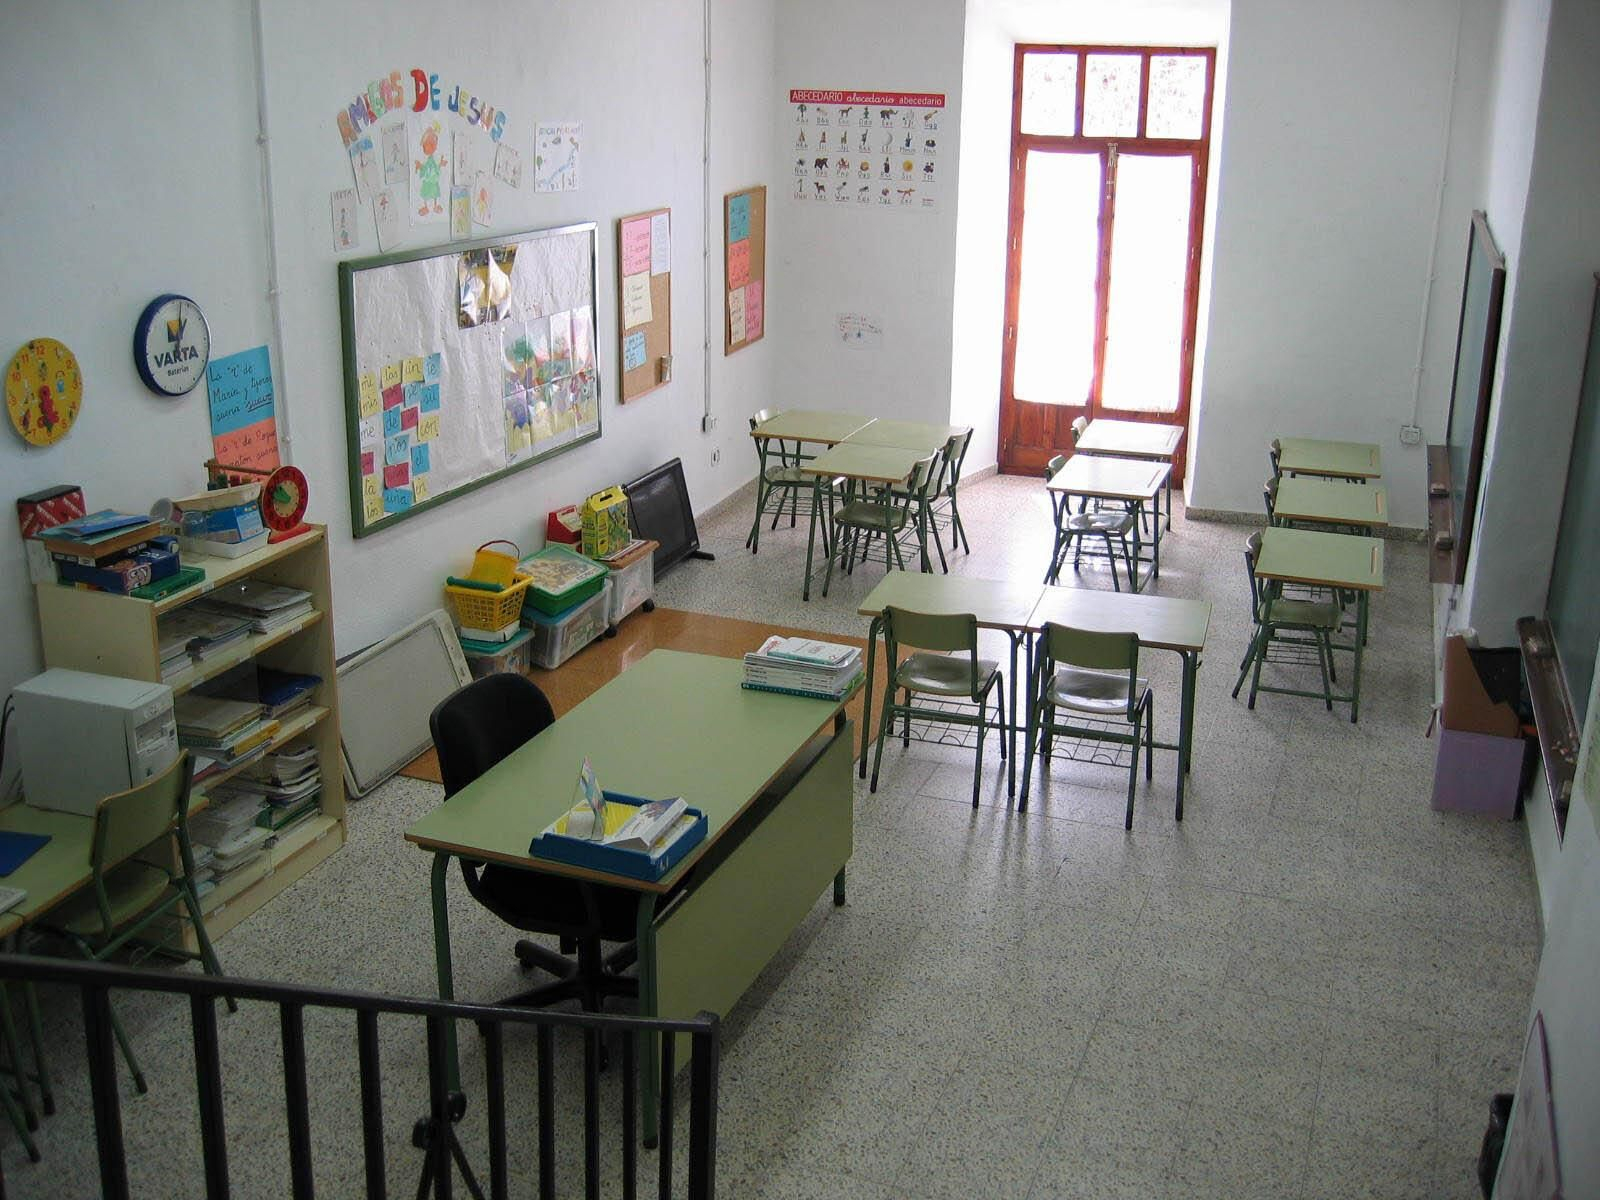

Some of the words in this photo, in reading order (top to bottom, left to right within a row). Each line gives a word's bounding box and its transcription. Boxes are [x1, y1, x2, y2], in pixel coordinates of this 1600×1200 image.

[337, 71, 404, 147] AMIGOS
[410, 68, 441, 113] DE
[448, 85, 507, 143] JESUS
[792, 90, 843, 102] ABECEDARIO
[846, 92, 895, 104] abecedario
[898, 95, 942, 106] abecedario
[154, 345, 199, 368] VARTA
[209, 366, 222, 382] La
[243, 362, 253, 375] de
[216, 406, 240, 422] suena
